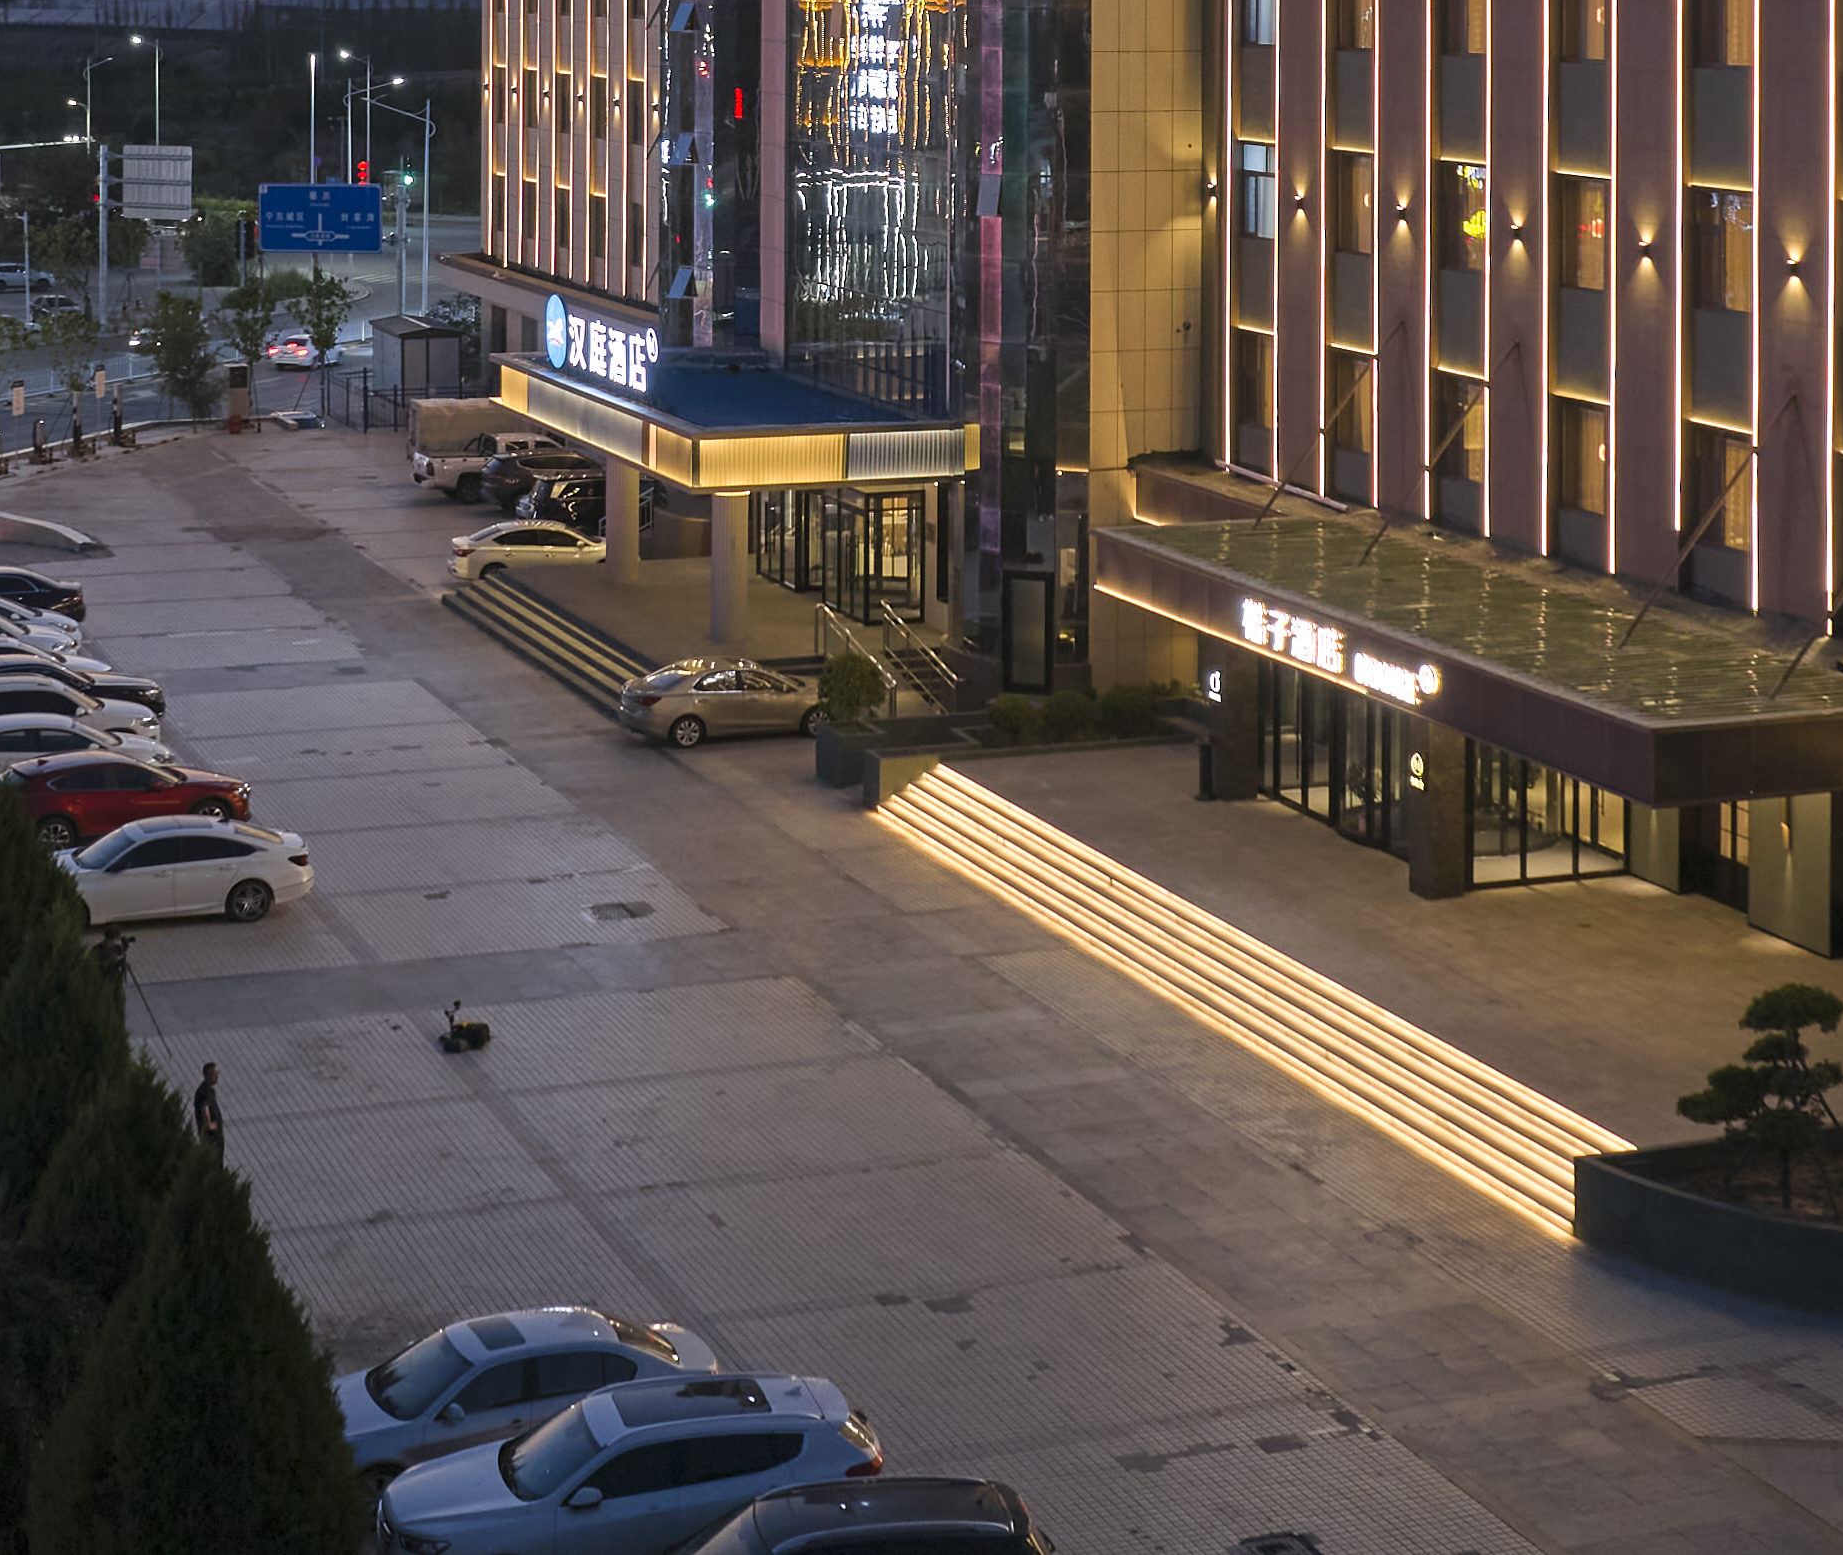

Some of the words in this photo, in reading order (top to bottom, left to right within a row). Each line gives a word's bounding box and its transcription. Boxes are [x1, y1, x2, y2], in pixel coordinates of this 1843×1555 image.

[568, 313, 647, 393] 汉庭酒店
[1242, 597, 1345, 674] 桔子酒店
